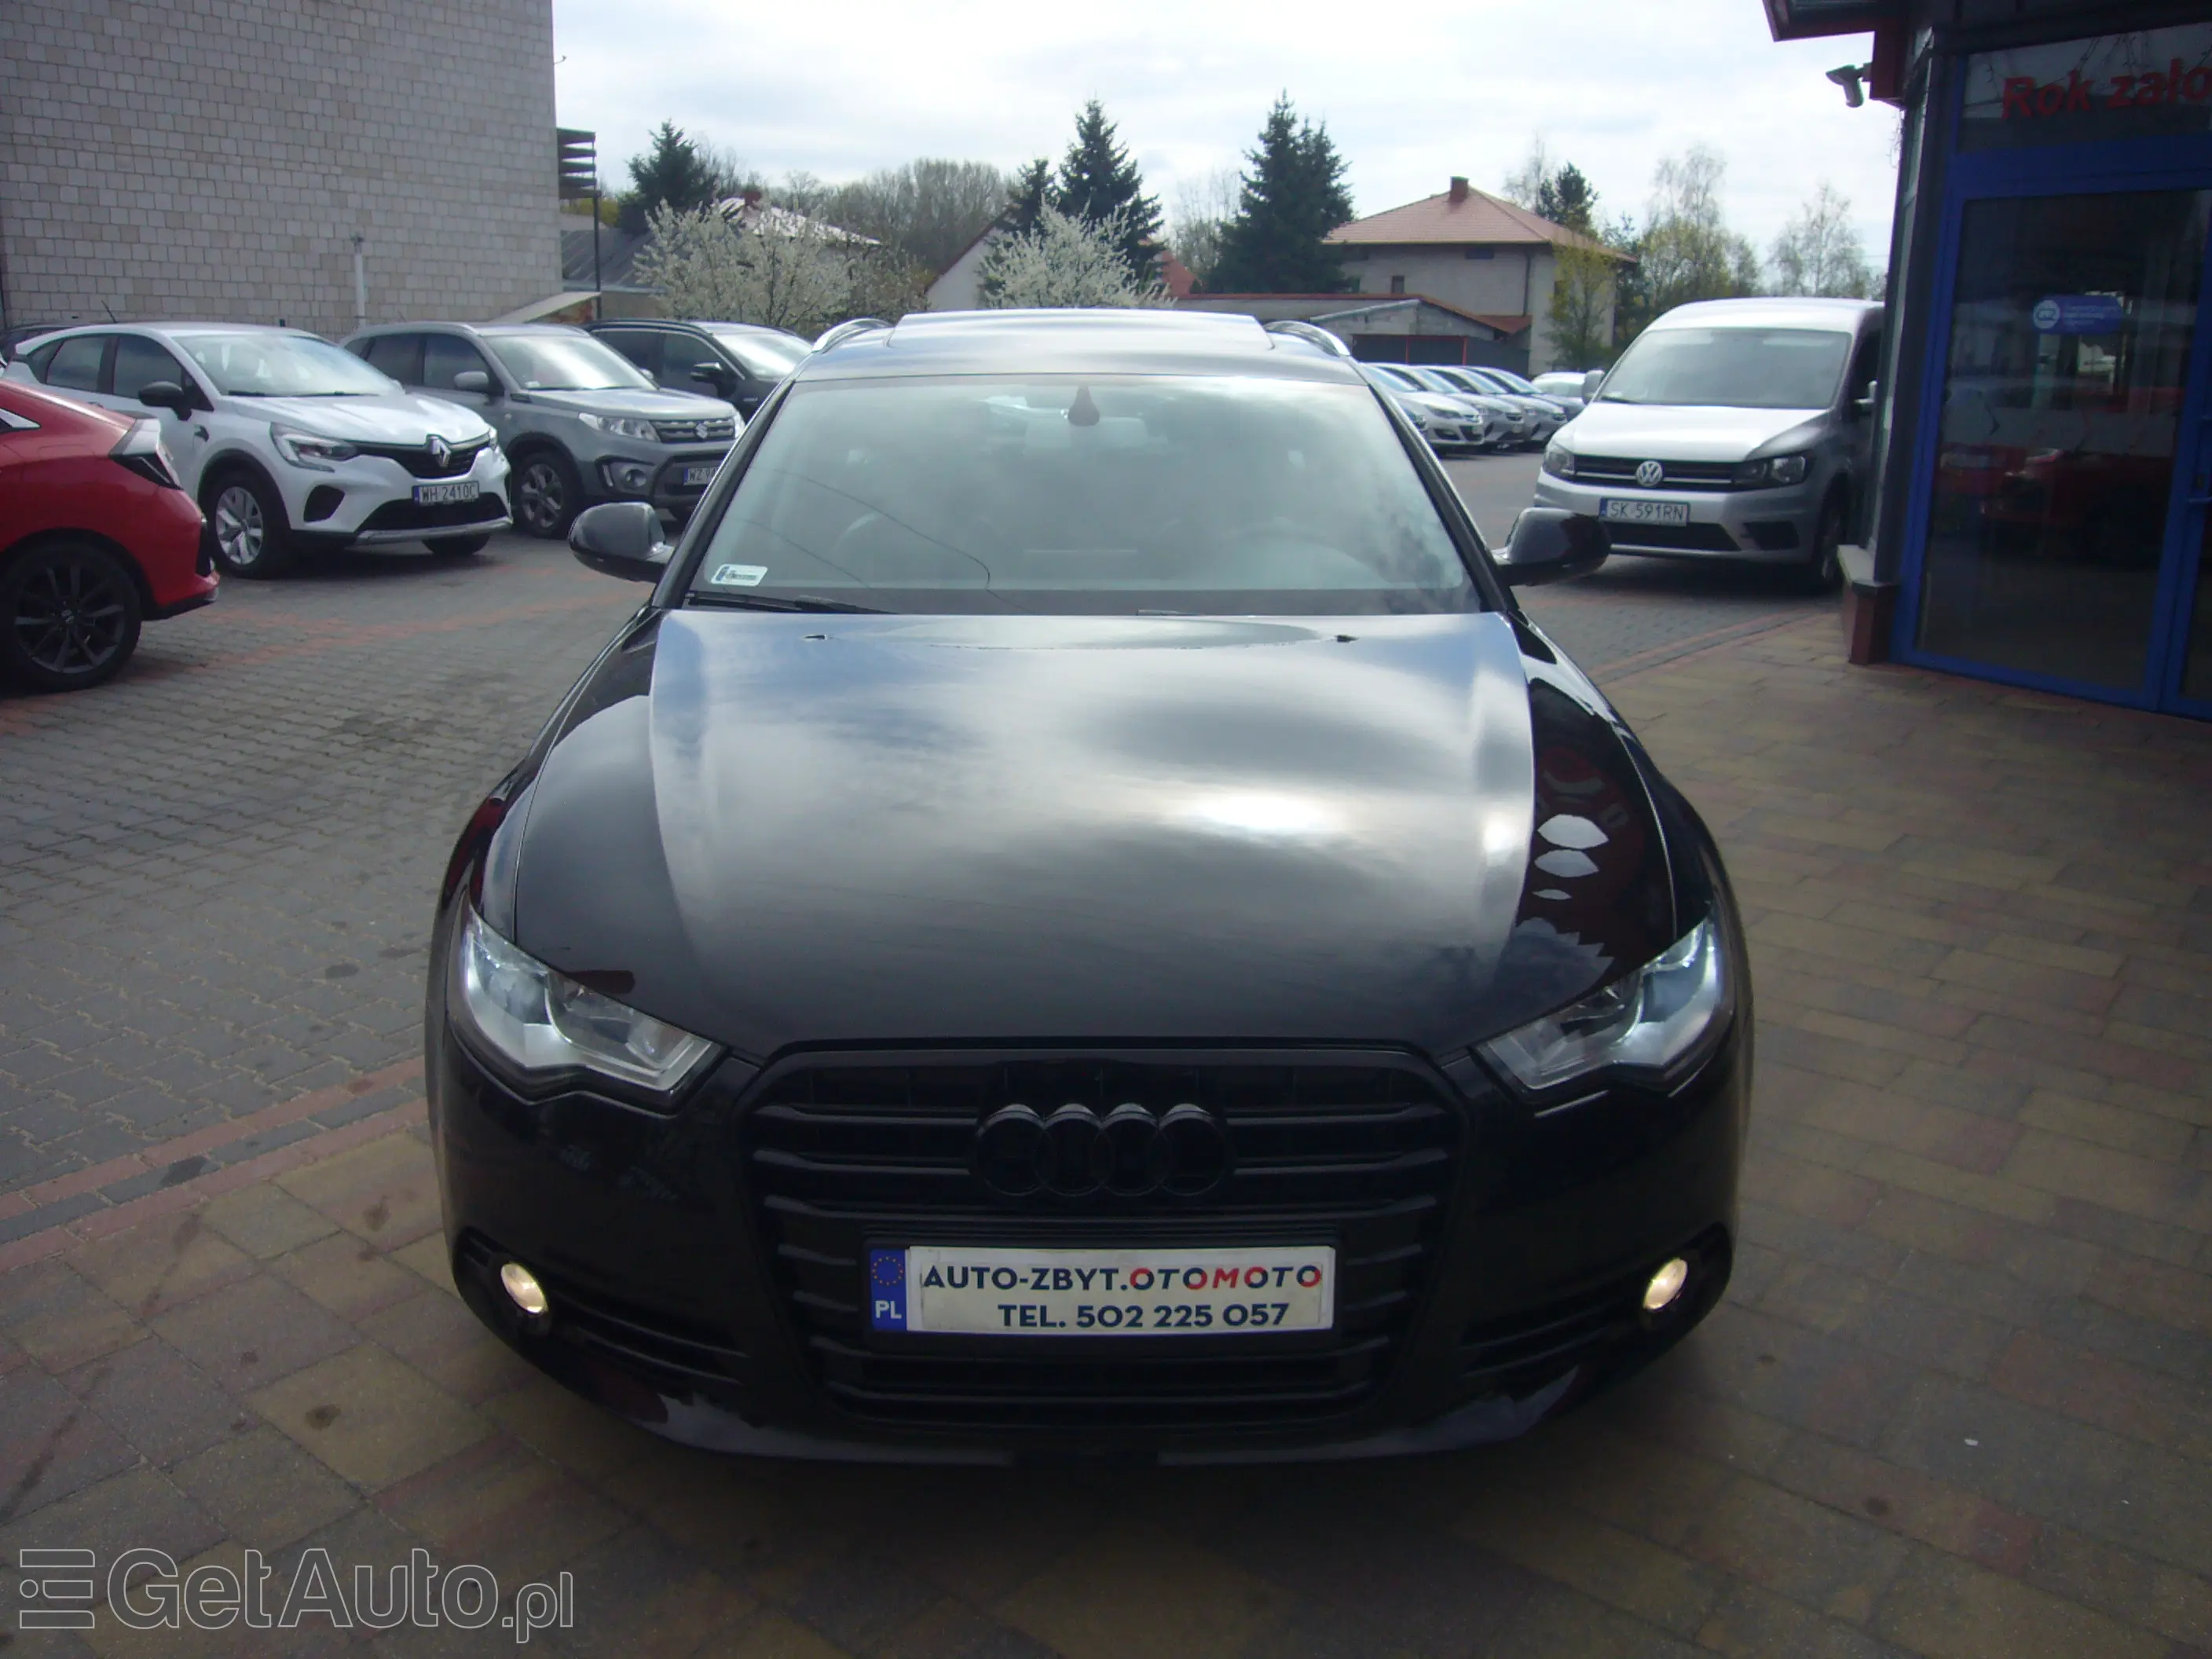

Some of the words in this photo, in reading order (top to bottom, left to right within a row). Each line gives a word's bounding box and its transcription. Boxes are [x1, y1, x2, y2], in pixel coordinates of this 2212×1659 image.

[2002, 69, 2093, 119] Rok
[422, 486, 438, 501] WH
[1611, 503, 1628, 518] SK
[1635, 504, 1683, 521] 591RN
[923, 1265, 1321, 1291] AUTO-ZBYT.OTOMOTO
[875, 1300, 902, 1319] PL
[998, 1304, 1066, 1328] TEL.
[1076, 1304, 1143, 1328] 502
[1153, 1304, 1213, 1328] 225
[1222, 1302, 1290, 1327] 057
